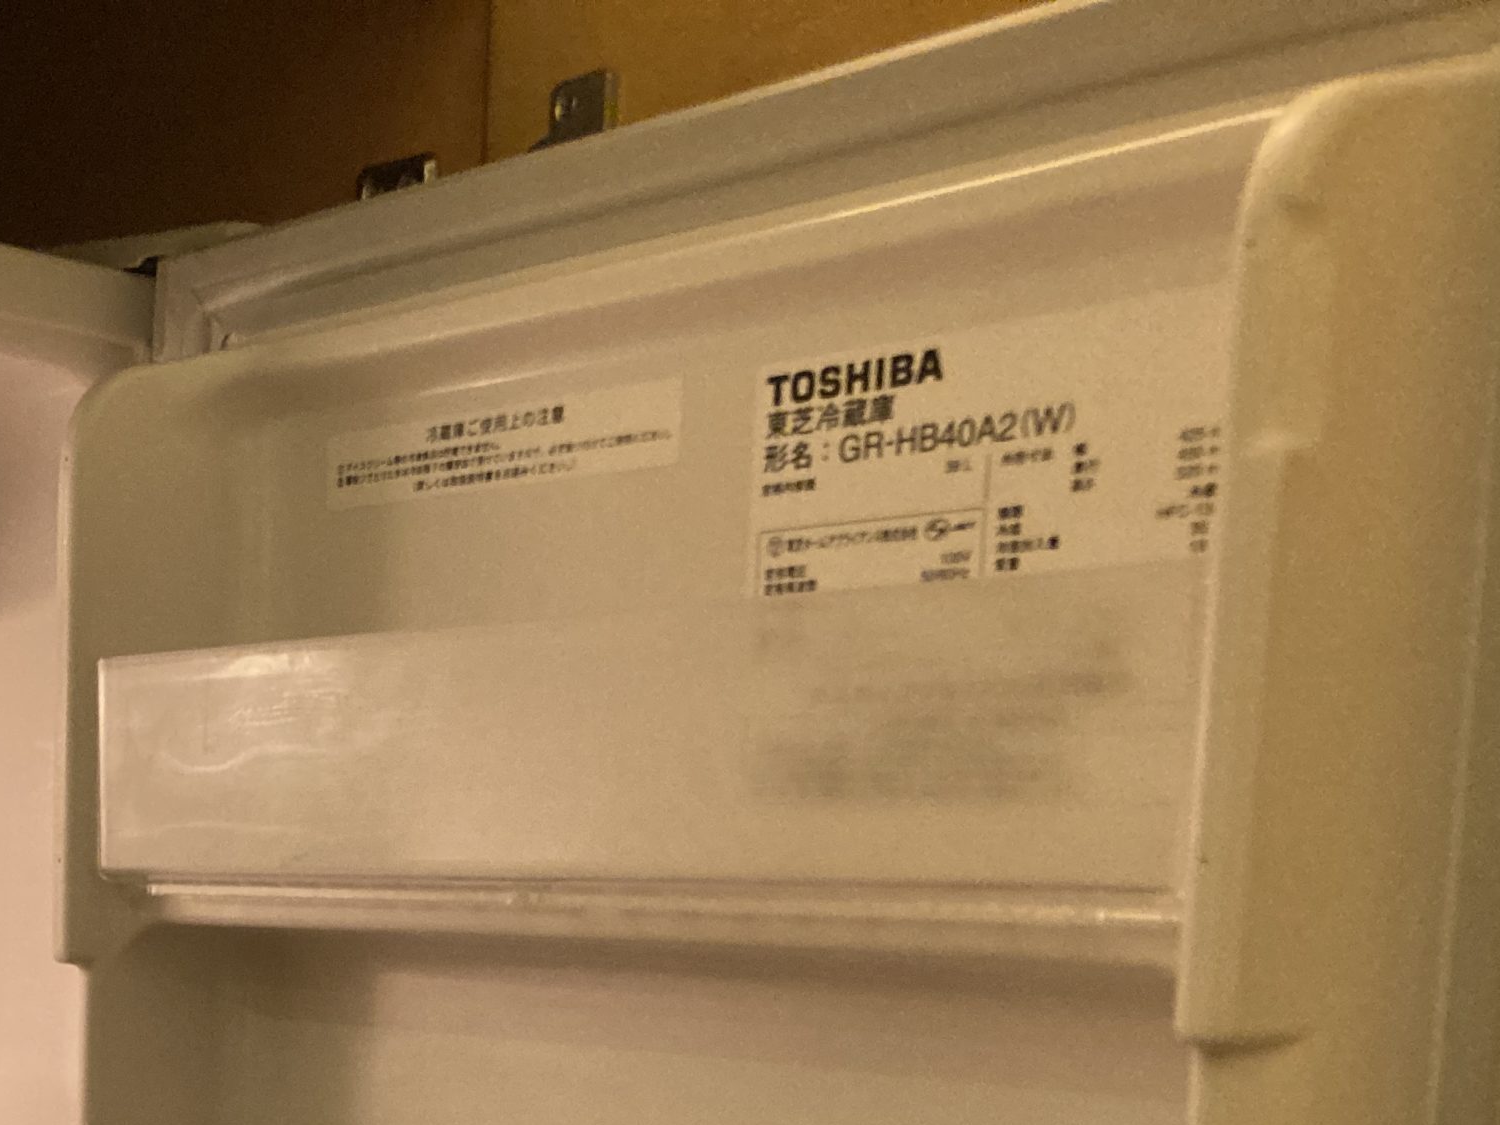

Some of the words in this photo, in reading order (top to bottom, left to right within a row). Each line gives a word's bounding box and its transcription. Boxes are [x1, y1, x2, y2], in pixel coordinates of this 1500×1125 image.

[766, 347, 944, 406] TOSHIBA
[764, 393, 896, 440] 東芝冷蔵庫
